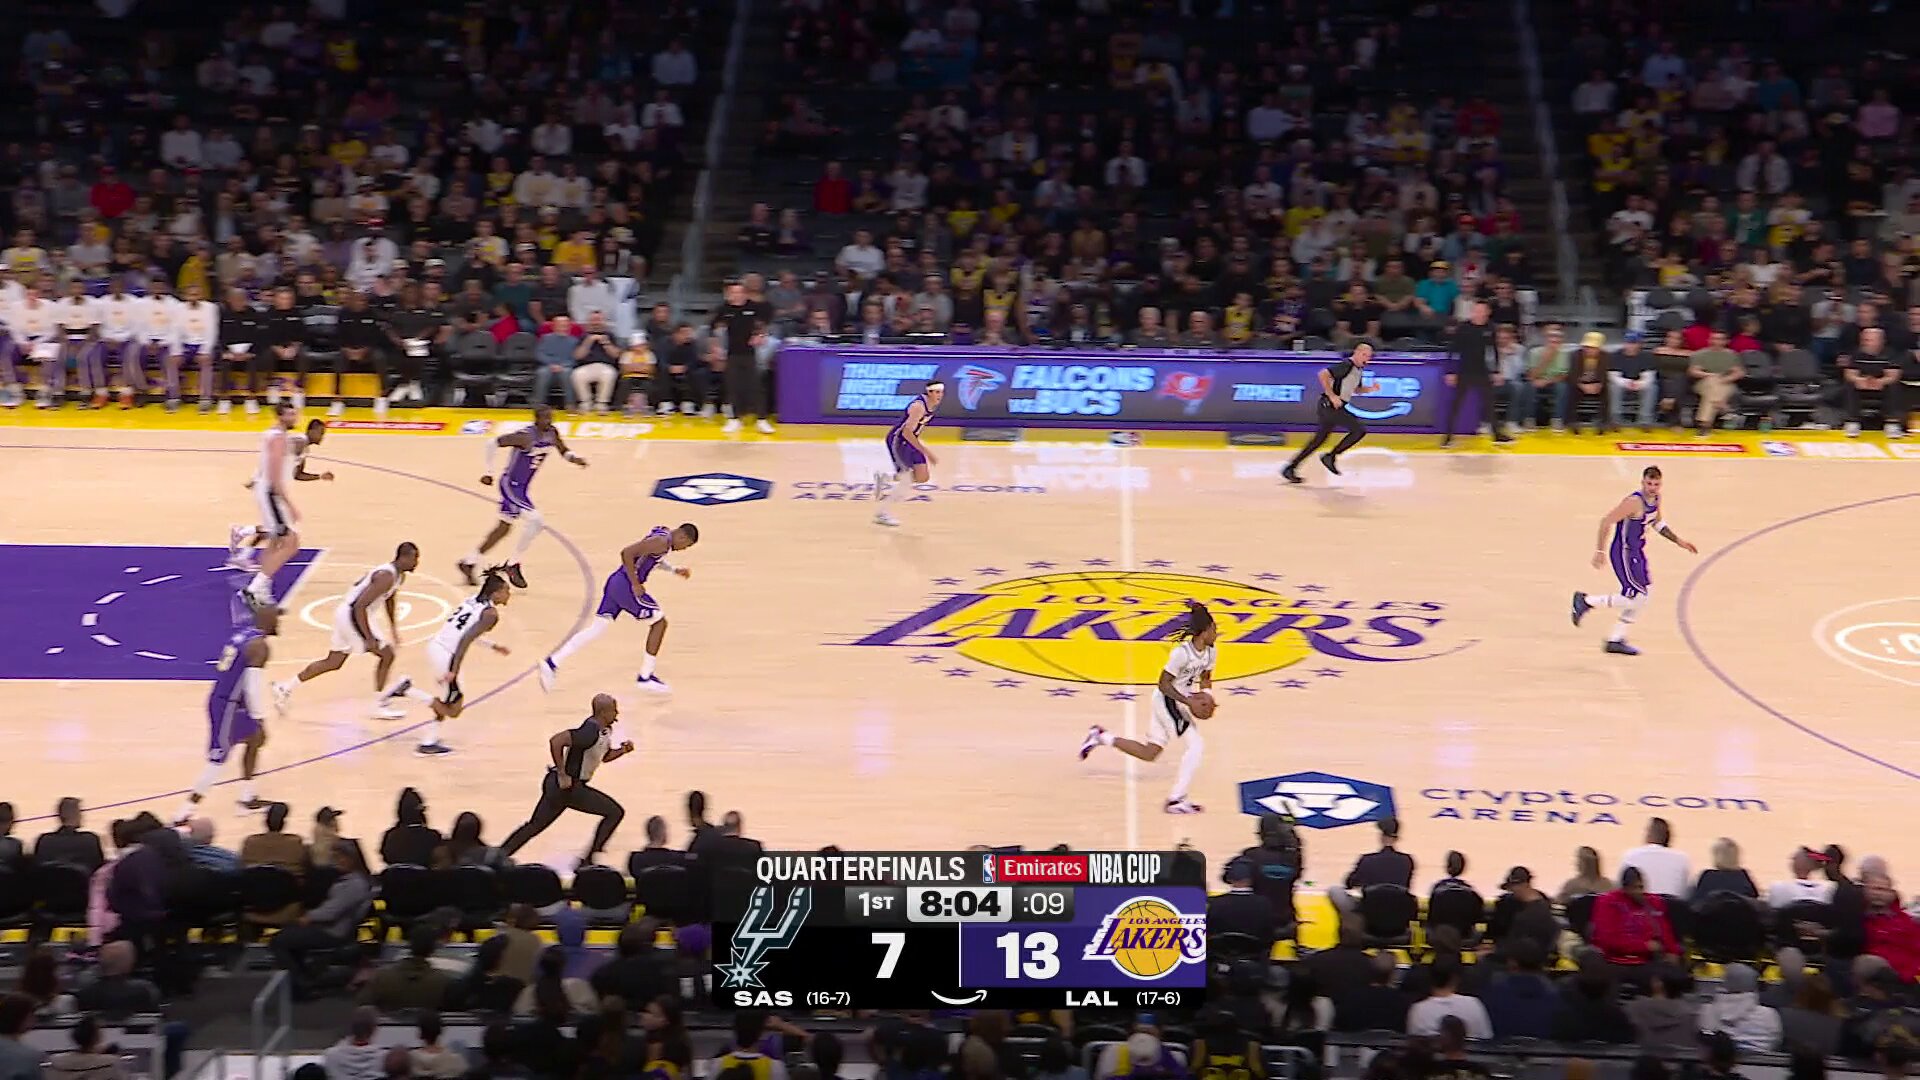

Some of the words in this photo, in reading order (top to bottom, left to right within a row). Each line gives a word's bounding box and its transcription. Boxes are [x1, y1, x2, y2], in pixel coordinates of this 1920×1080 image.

[1011, 364, 1156, 391] FALCONS
[1036, 389, 1123, 415] BUCS
[792, 481, 1047, 494] crypo.com
[1034, 594, 1142, 605] LOS
[1420, 787, 1771, 812] crypto.com
[1430, 806, 1623, 826] ARENA
